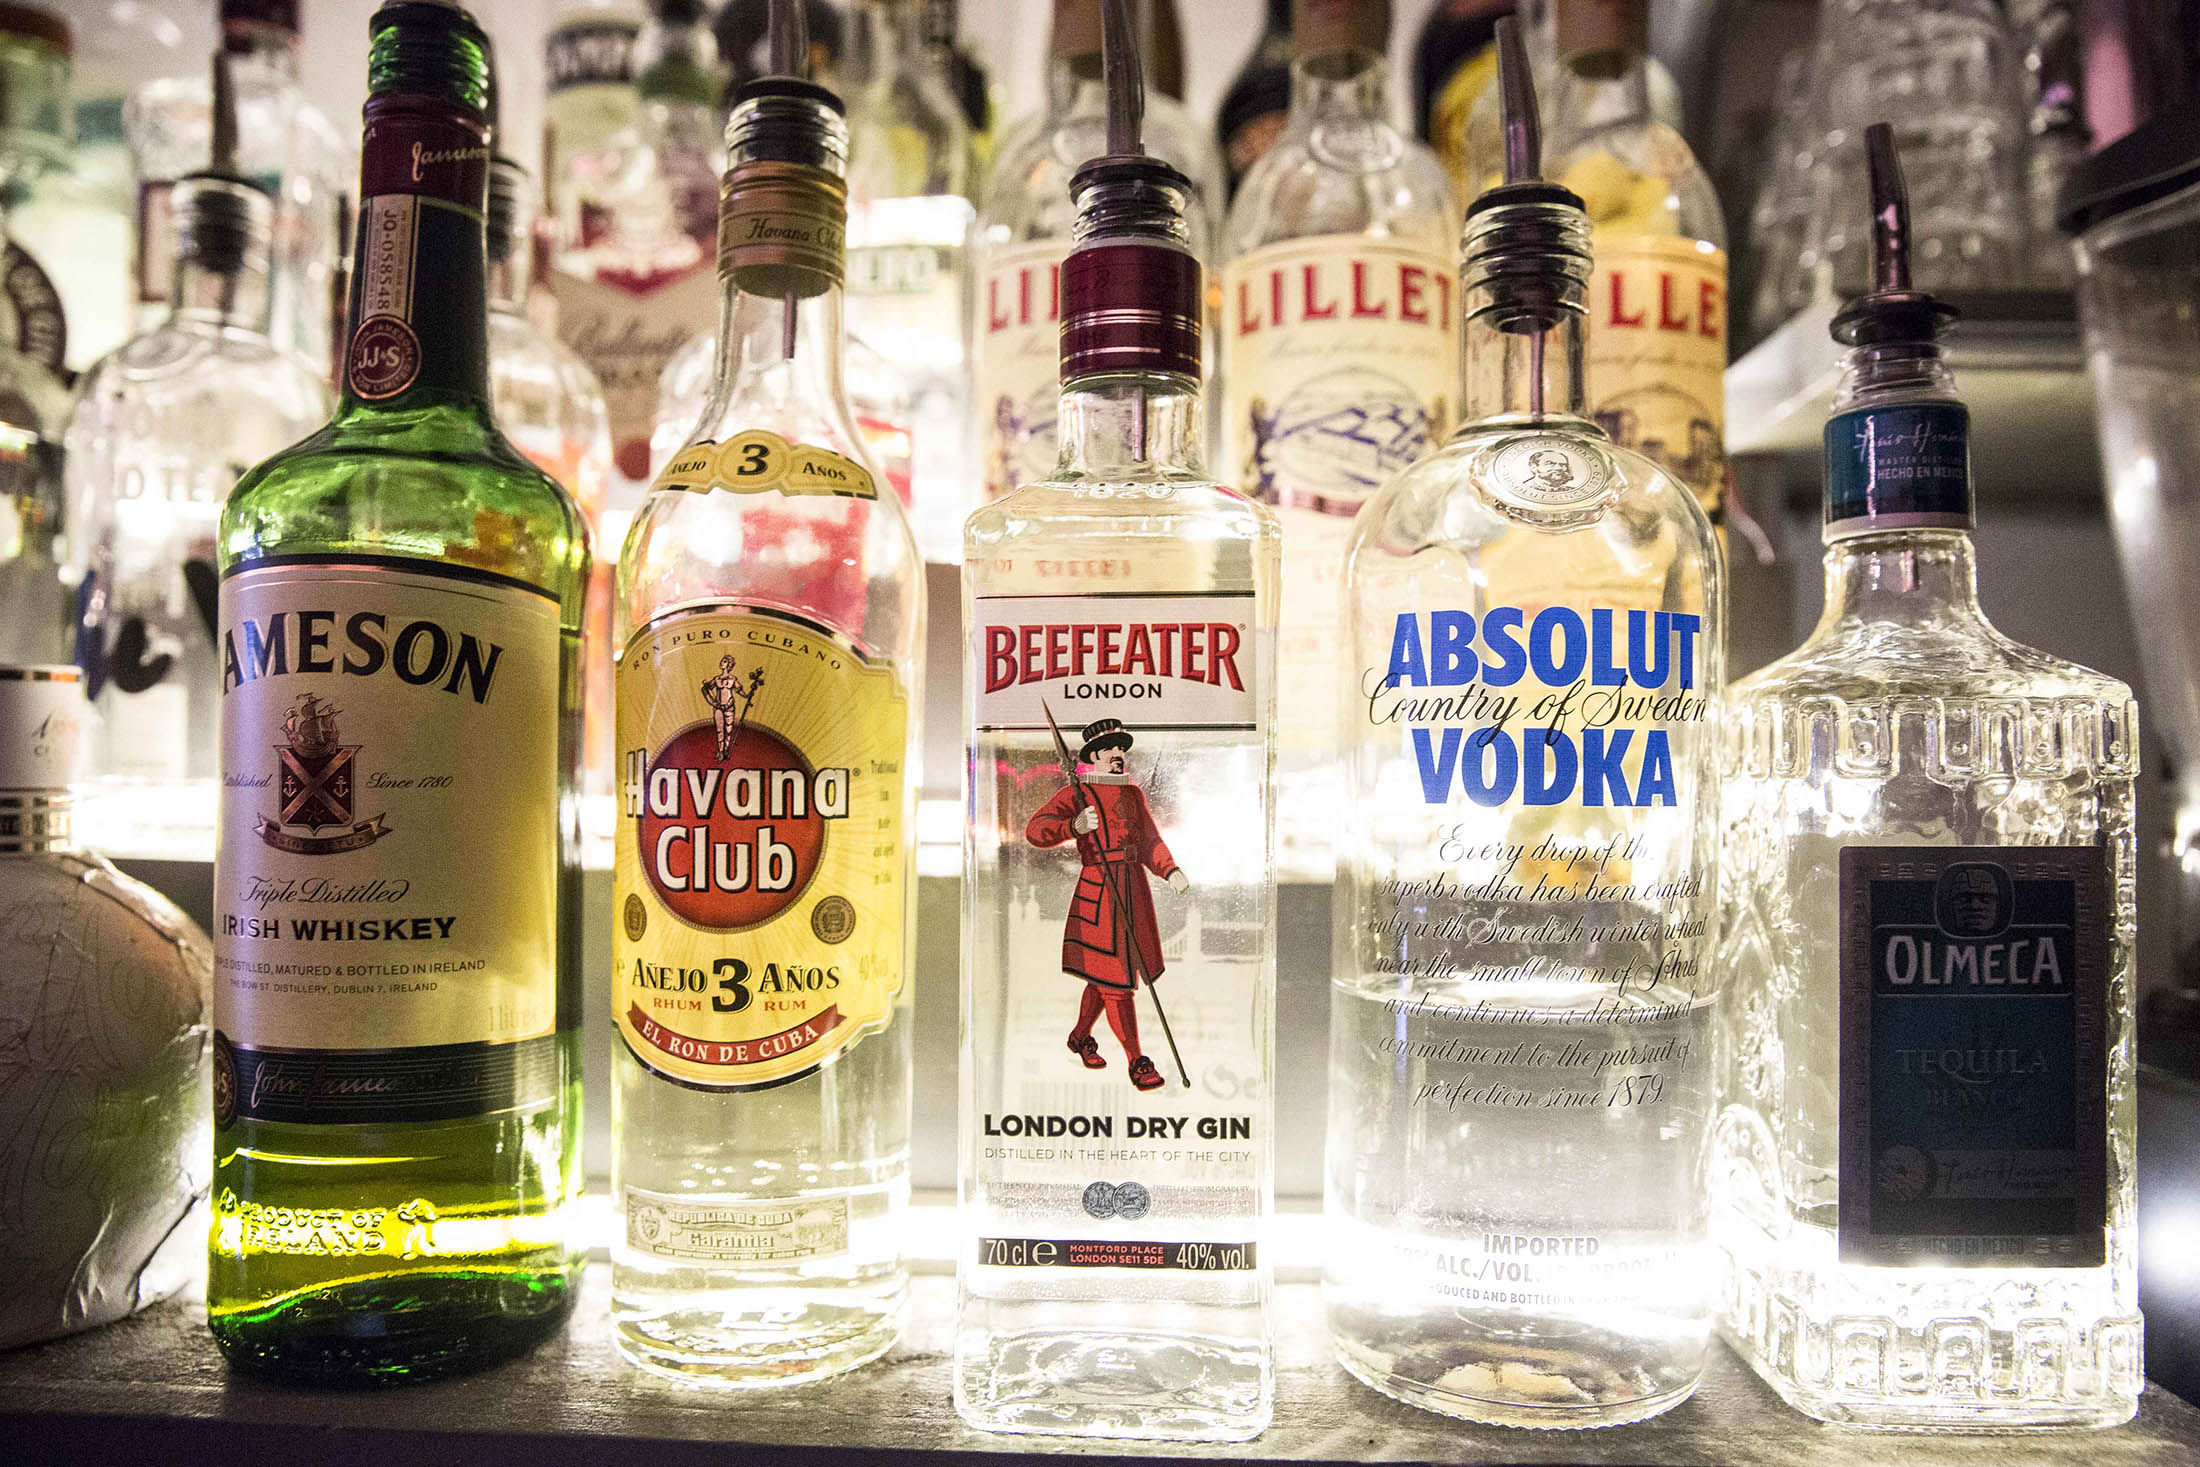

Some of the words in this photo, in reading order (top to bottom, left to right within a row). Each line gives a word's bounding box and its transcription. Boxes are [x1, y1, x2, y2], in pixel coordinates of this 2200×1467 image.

[744, 217, 811, 242] Havana
[736, 443, 771, 476] 3
[1877, 466, 1914, 481] HECHO
[1916, 466, 1931, 479] EN
[671, 628, 731, 646] PURO
[746, 630, 842, 672] CUBANO
[984, 622, 1247, 695] BEEFEATER
[1385, 605, 1702, 690] ABSOLUT
[1063, 682, 1163, 700] LONDON
[1360, 666, 1521, 749] Country
[1523, 678, 1587, 747] of
[1579, 674, 1706, 733] Sweden
[365, 770, 414, 790] Since
[418, 774, 454, 790] 1780
[624, 747, 851, 820] Havana
[1411, 727, 1678, 808] VODKA
[655, 825, 798, 894] Club
[1436, 823, 1525, 875] Every
[1527, 833, 1589, 872] drop
[1592, 832, 1624, 873] of
[238, 875, 298, 910] Triple
[298, 877, 411, 904] Distilled
[1380, 871, 1446, 907] superb
[1446, 873, 1523, 901] vodka
[1528, 871, 1579, 902] has
[1584, 871, 1637, 902] been
[1640, 868, 1706, 916] crafted
[223, 913, 280, 940] IRISH
[289, 916, 457, 942] WHISKEY
[1413, 912, 1465, 943] with
[1464, 905, 1585, 949] Swedish
[1588, 915, 1660, 944] winter
[1663, 910, 1707, 946] wheat
[274, 964, 331, 977] MATURED
[334, 965, 344, 976] &
[346, 963, 410, 977] BOTTLED
[412, 961, 427, 974] IN
[429, 958, 486, 974] IRELAND
[1375, 955, 1425, 977] near
[1422, 950, 1460, 981] the
[1464, 953, 1543, 984] small
[1543, 957, 1608, 984] town
[1611, 953, 1642, 998] of
[1884, 934, 2064, 986] OLMECA
[333, 983, 375, 994] DUBLIN
[388, 982, 438, 994] IRELAND
[631, 957, 709, 993] AÑEJO
[710, 957, 753, 1014] 3
[757, 962, 841, 993] AÑOS
[652, 996, 703, 1012] RHUM
[763, 998, 808, 1012] RUM
[1382, 991, 1429, 1017] and
[1558, 1008, 1575, 1026] a
[1581, 990, 1696, 1026] determined
[641, 1018, 663, 1047] EL
[668, 1039, 709, 1061] RON
[718, 1043, 749, 1063] DE
[758, 1023, 820, 1059] CUBA
[1527, 1041, 1555, 1068] to
[1555, 1040, 1594, 1068] the
[1594, 1038, 1677, 1078] pursuit
[1894, 1047, 2052, 1084] TEQUILA
[1414, 1072, 1533, 1112] perfection
[1538, 1082, 1603, 1109] since
[984, 1113, 1113, 1139] LONDON
[1126, 1116, 1189, 1140] DRY
[1196, 1116, 1251, 1140] GIN
[984, 1147, 1055, 1161] DISTILLED
[1059, 1148, 1074, 1161] IN
[1078, 1148, 1105, 1161] THE
[1110, 1149, 1157, 1162] HEART
[1163, 1149, 1182, 1162] OF
[1185, 1150, 1214, 1162] THE
[1218, 1151, 1251, 1163] CITY
[1069, 1243, 1129, 1254] MONTFORD
[1130, 1245, 1165, 1255] PLACE
[1069, 1253, 1117, 1265] LONDON
[1118, 1254, 1141, 1265] SE11
[1142, 1255, 1165, 1266] 5DE
[1175, 1243, 1217, 1270] 40%
[1220, 1244, 1251, 1270] vol.
[1483, 1233, 1600, 1257] IMPORTED
[1435, 1253, 1541, 1283] ALC./VOL.
[1424, 1281, 1481, 1301] ODUCED
[1482, 1289, 1508, 1304] AND
[1510, 1292, 1560, 1306] BOTTLED
